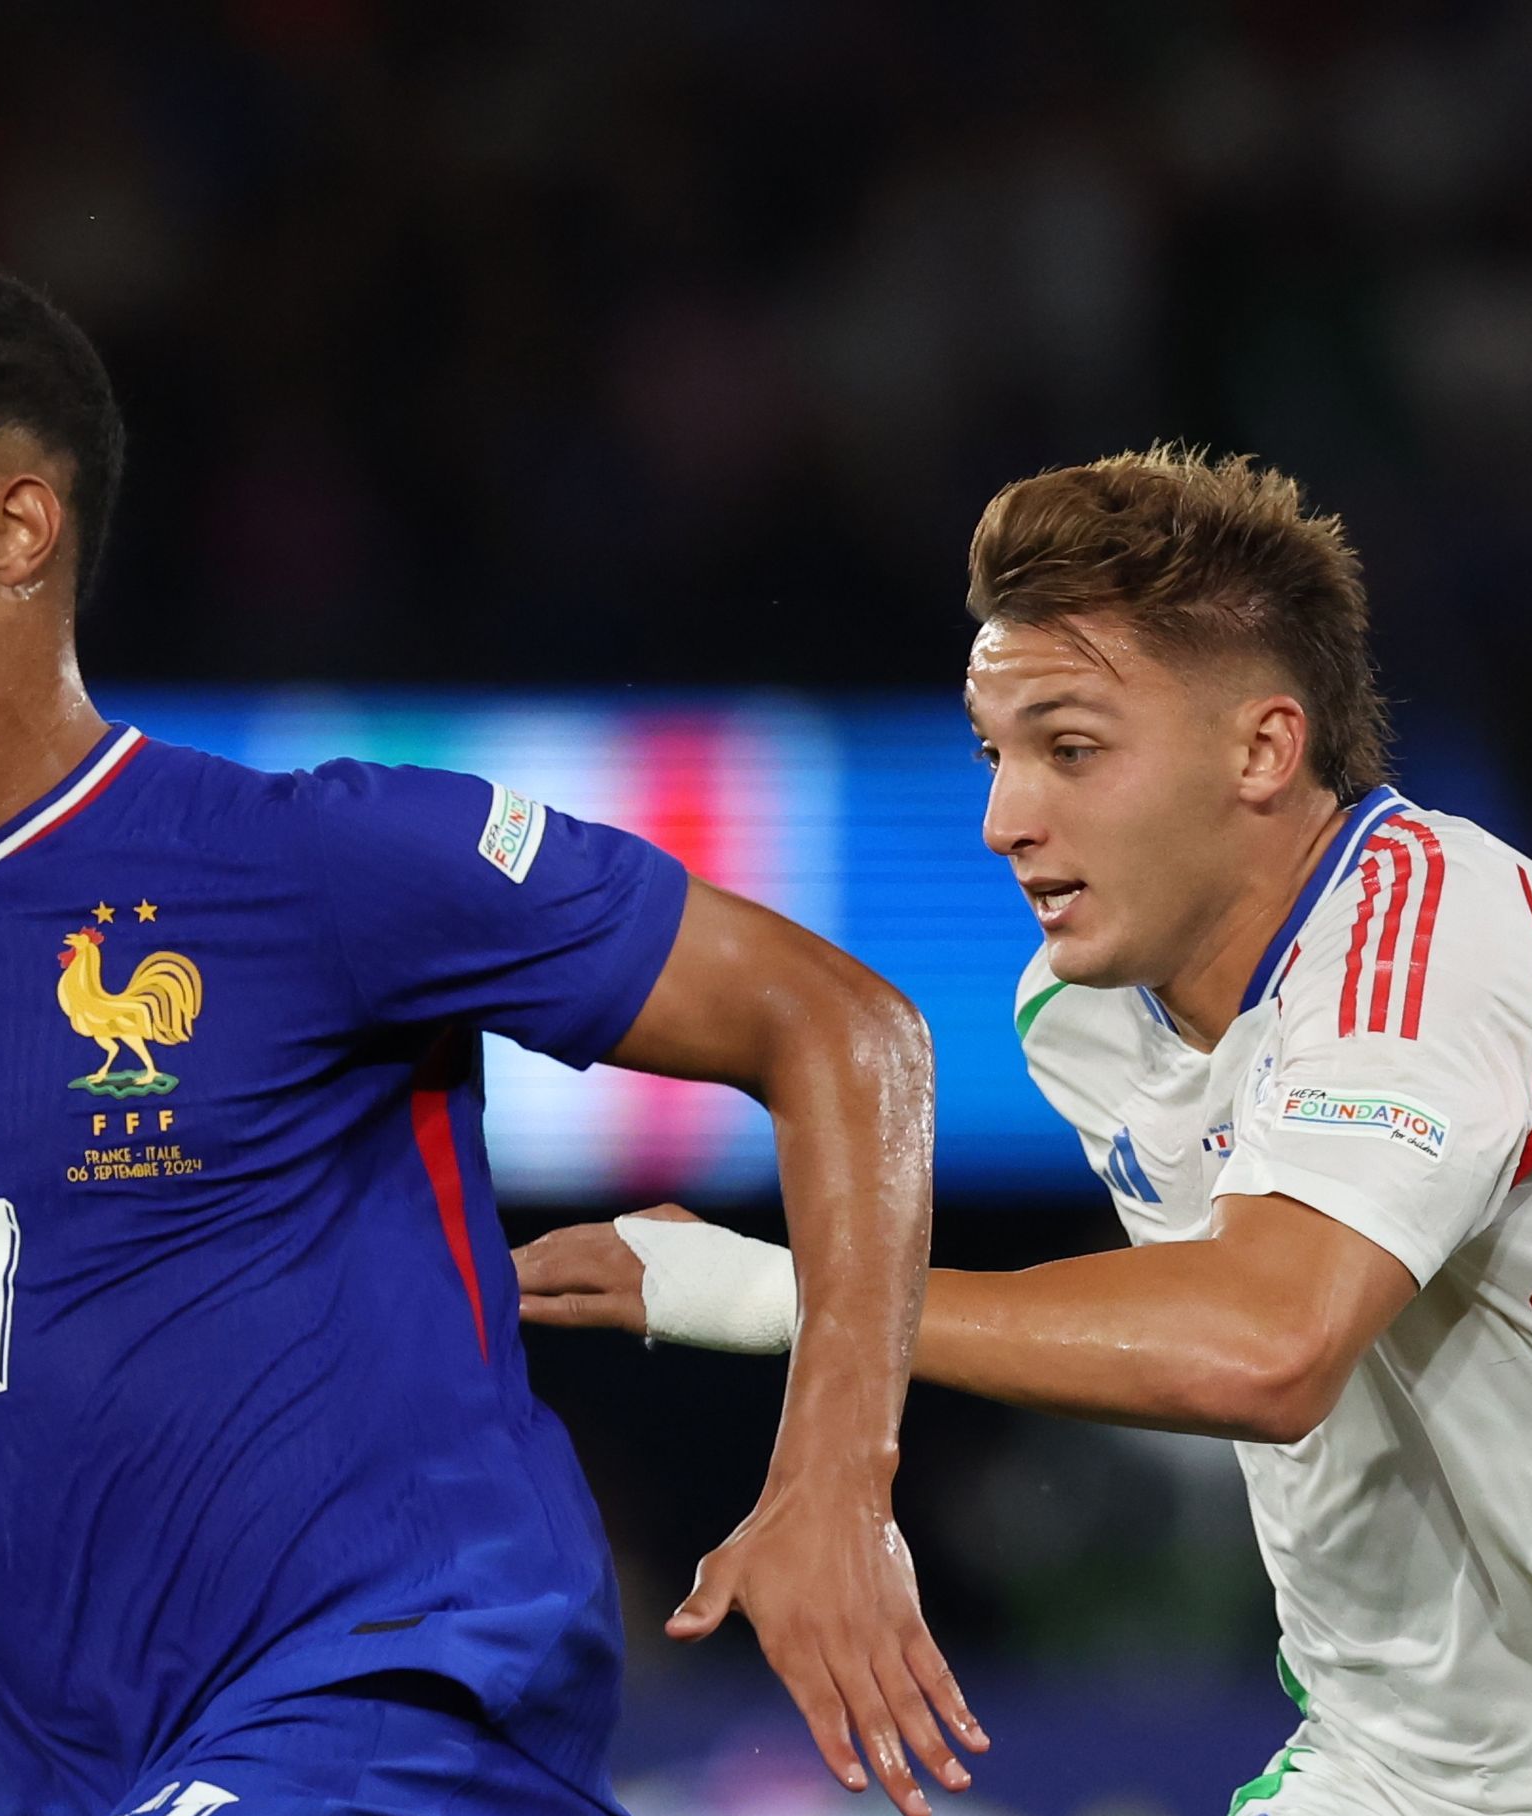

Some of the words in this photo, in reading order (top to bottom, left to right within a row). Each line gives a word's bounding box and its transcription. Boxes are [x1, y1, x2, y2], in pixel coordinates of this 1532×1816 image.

[484, 824, 501, 855] UEFA
[1289, 1088, 1328, 1100] UEFA
[84, 1147, 132, 1165] FRANCE
[145, 1145, 181, 1162] ITALIE
[1390, 1129, 1406, 1140] for
[1407, 1137, 1438, 1158] children
[67, 1166, 89, 1182] 06
[94, 1162, 159, 1181] SEPTEMBRE
[164, 1158, 203, 1176] 2024
